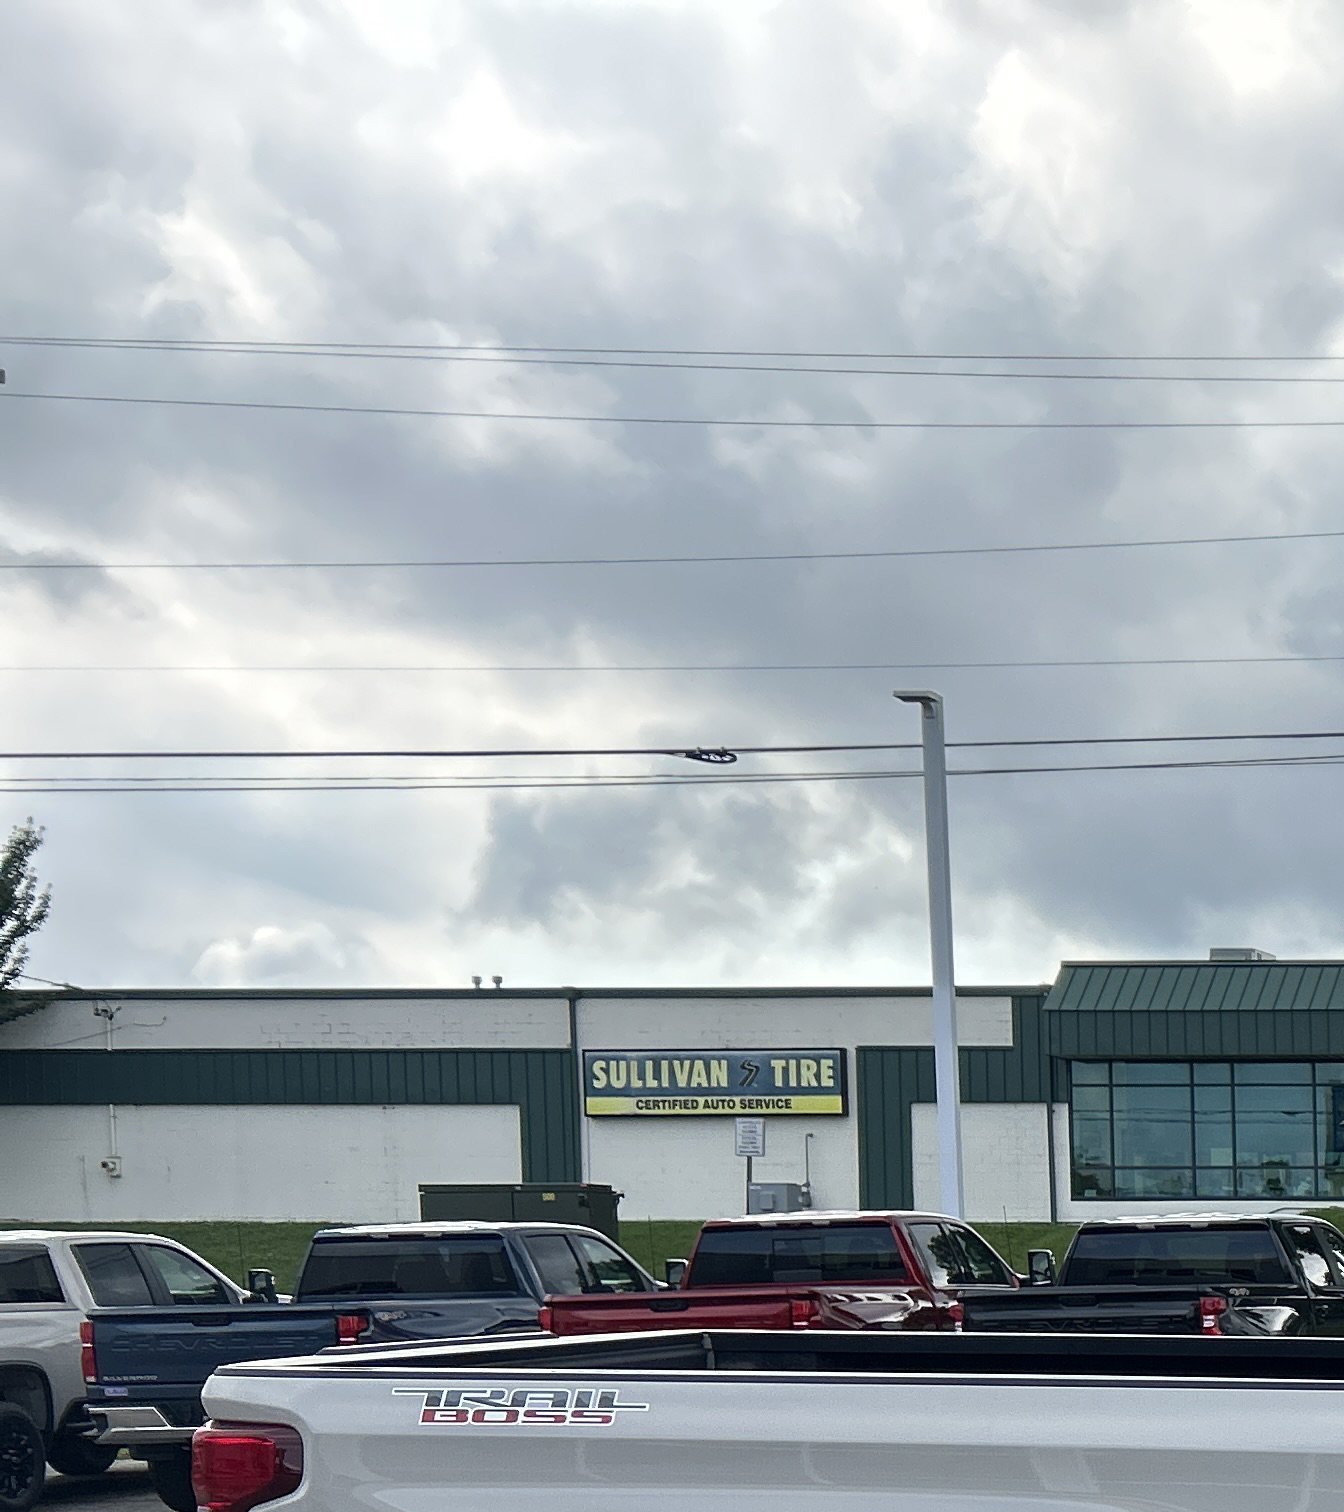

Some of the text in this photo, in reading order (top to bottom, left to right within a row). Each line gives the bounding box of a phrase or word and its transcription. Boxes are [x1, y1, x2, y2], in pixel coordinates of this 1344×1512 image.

[592, 1059, 834, 1089] SULLIVAN TIRE
[635, 1098, 792, 1110] CERTIFIED AUTO SERVICE
[392, 1388, 649, 1411] TRAIL
[418, 1408, 616, 1426] BOSS
